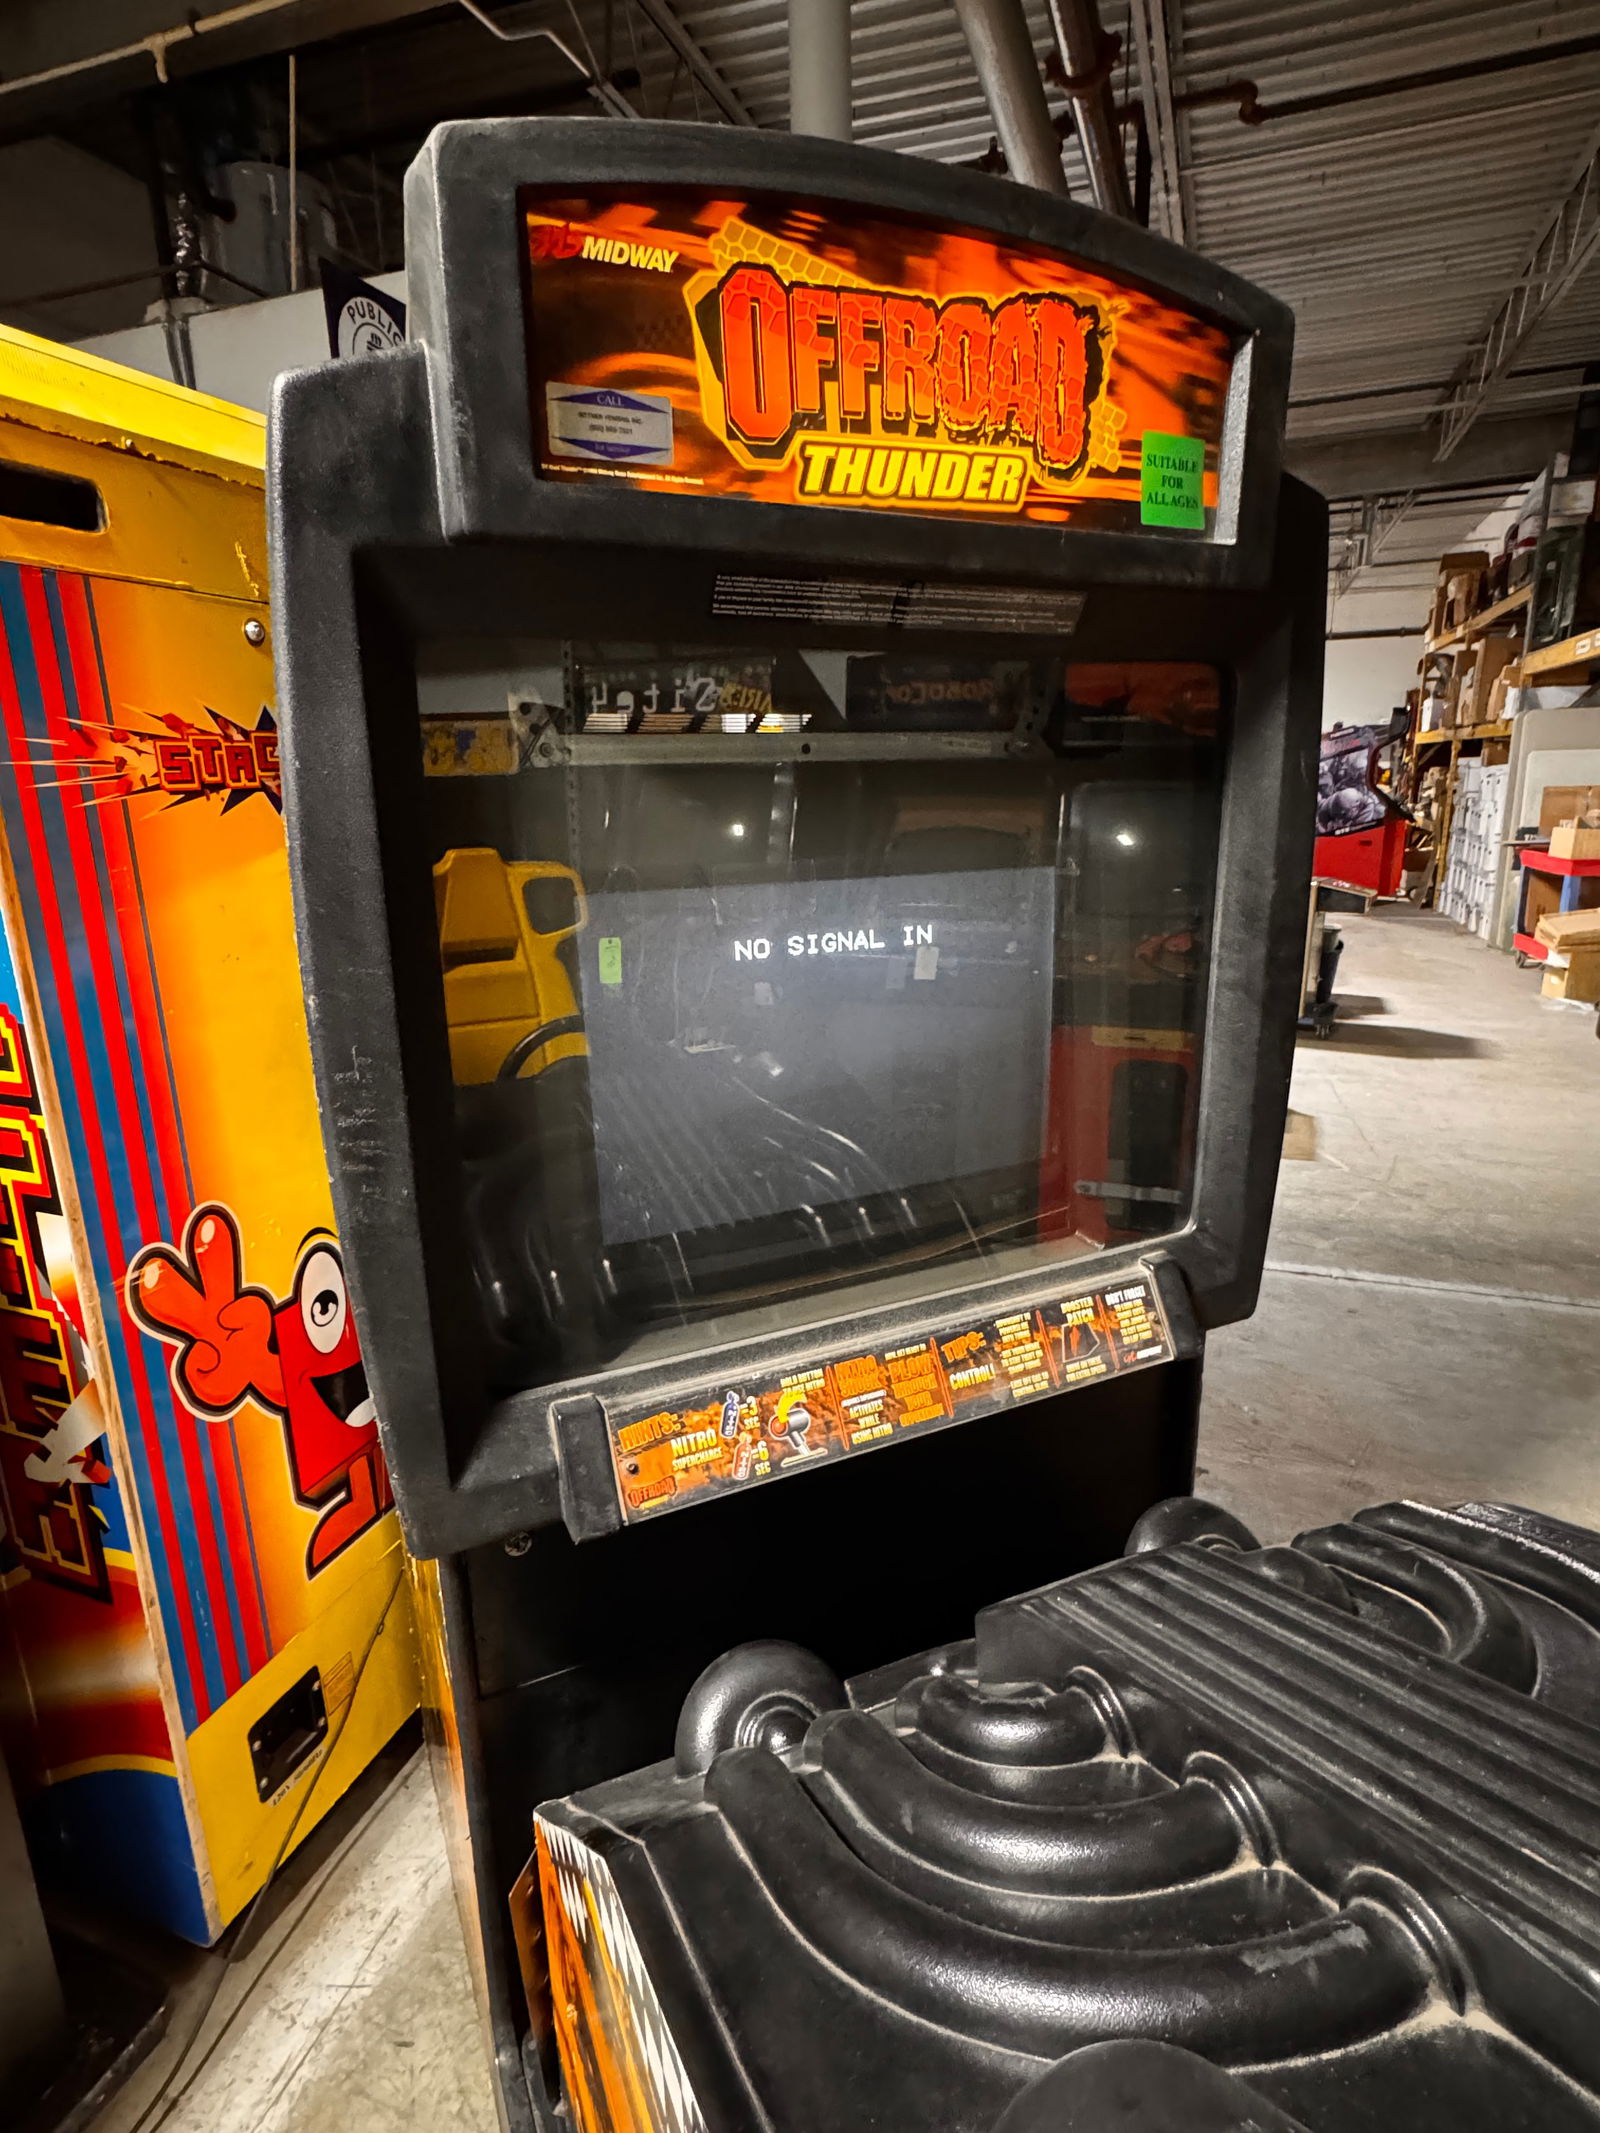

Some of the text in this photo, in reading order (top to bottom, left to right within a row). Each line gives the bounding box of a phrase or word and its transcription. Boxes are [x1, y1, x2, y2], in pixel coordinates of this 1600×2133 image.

[582, 236, 679, 272] MIDWAY
[347, 300, 402, 347] PUBLIC
[720, 268, 1088, 468] OFFROAD
[597, 394, 624, 406] CALL
[802, 444, 1024, 502] THUNDER
[1147, 453, 1198, 473] SUITABLE
[1162, 475, 1183, 489] FOR
[1147, 491, 1198, 508] ALL AGES
[734, 924, 933, 961] NO SIGNAL IN
[1066, 1307, 1095, 1326] PATCH
[941, 1331, 986, 1363] TIPS:
[888, 1354, 932, 1382] PLOW
[850, 1399, 884, 1419] ACTIVATES
[904, 1391, 933, 1411] YOUR
[744, 1416, 760, 1430] SEC
[858, 1413, 881, 1429] WHILE
[617, 1412, 681, 1452] HINTS:
[671, 1428, 717, 1457] NITRO
[851, 1423, 894, 1444] USING NITRO
[672, 1447, 723, 1471] SUPERCHARGE
[755, 1461, 771, 1475] SEC
